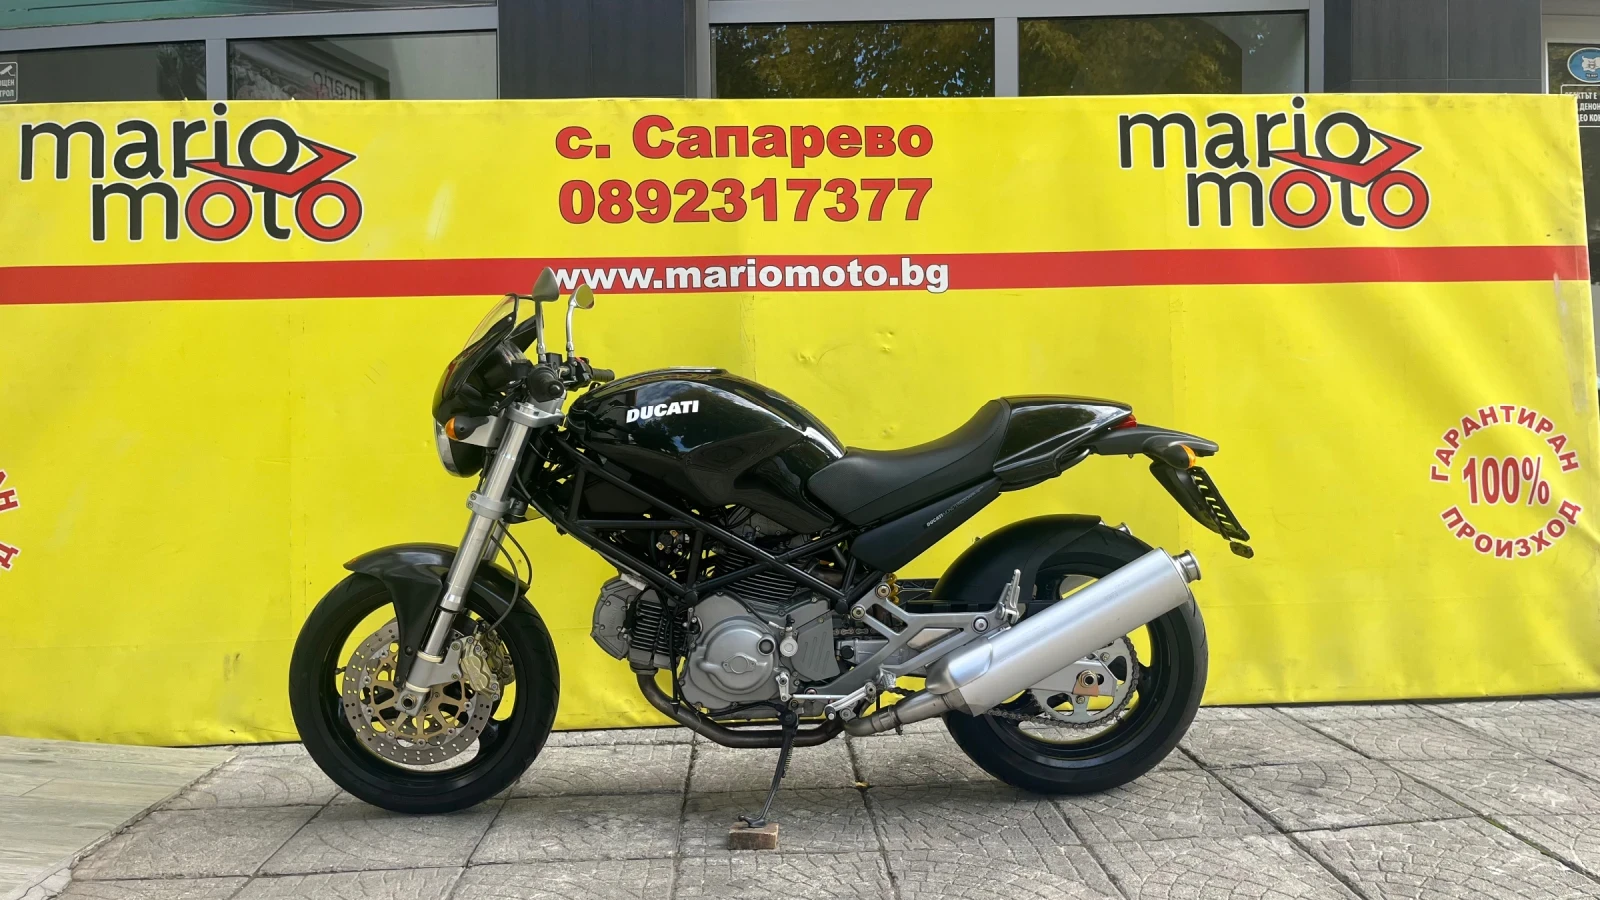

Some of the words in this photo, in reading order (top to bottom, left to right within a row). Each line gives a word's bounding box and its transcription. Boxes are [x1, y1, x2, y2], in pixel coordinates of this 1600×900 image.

[20, 102, 301, 181] mario
[555, 125, 611, 159] с.
[632, 114, 933, 169] Сапарево
[1118, 95, 1372, 169] mario
[92, 180, 363, 242] moto
[558, 177, 933, 224] 0892317377
[1187, 169, 1430, 230] moto
[554, 257, 950, 294] www.mariomoto.bg
[626, 400, 699, 423] DUCATI
[1430, 405, 1580, 482] ГАРАНТИРАН
[1463, 456, 1550, 506] 100%
[1441, 500, 1582, 559] ПРОИЗХОД
